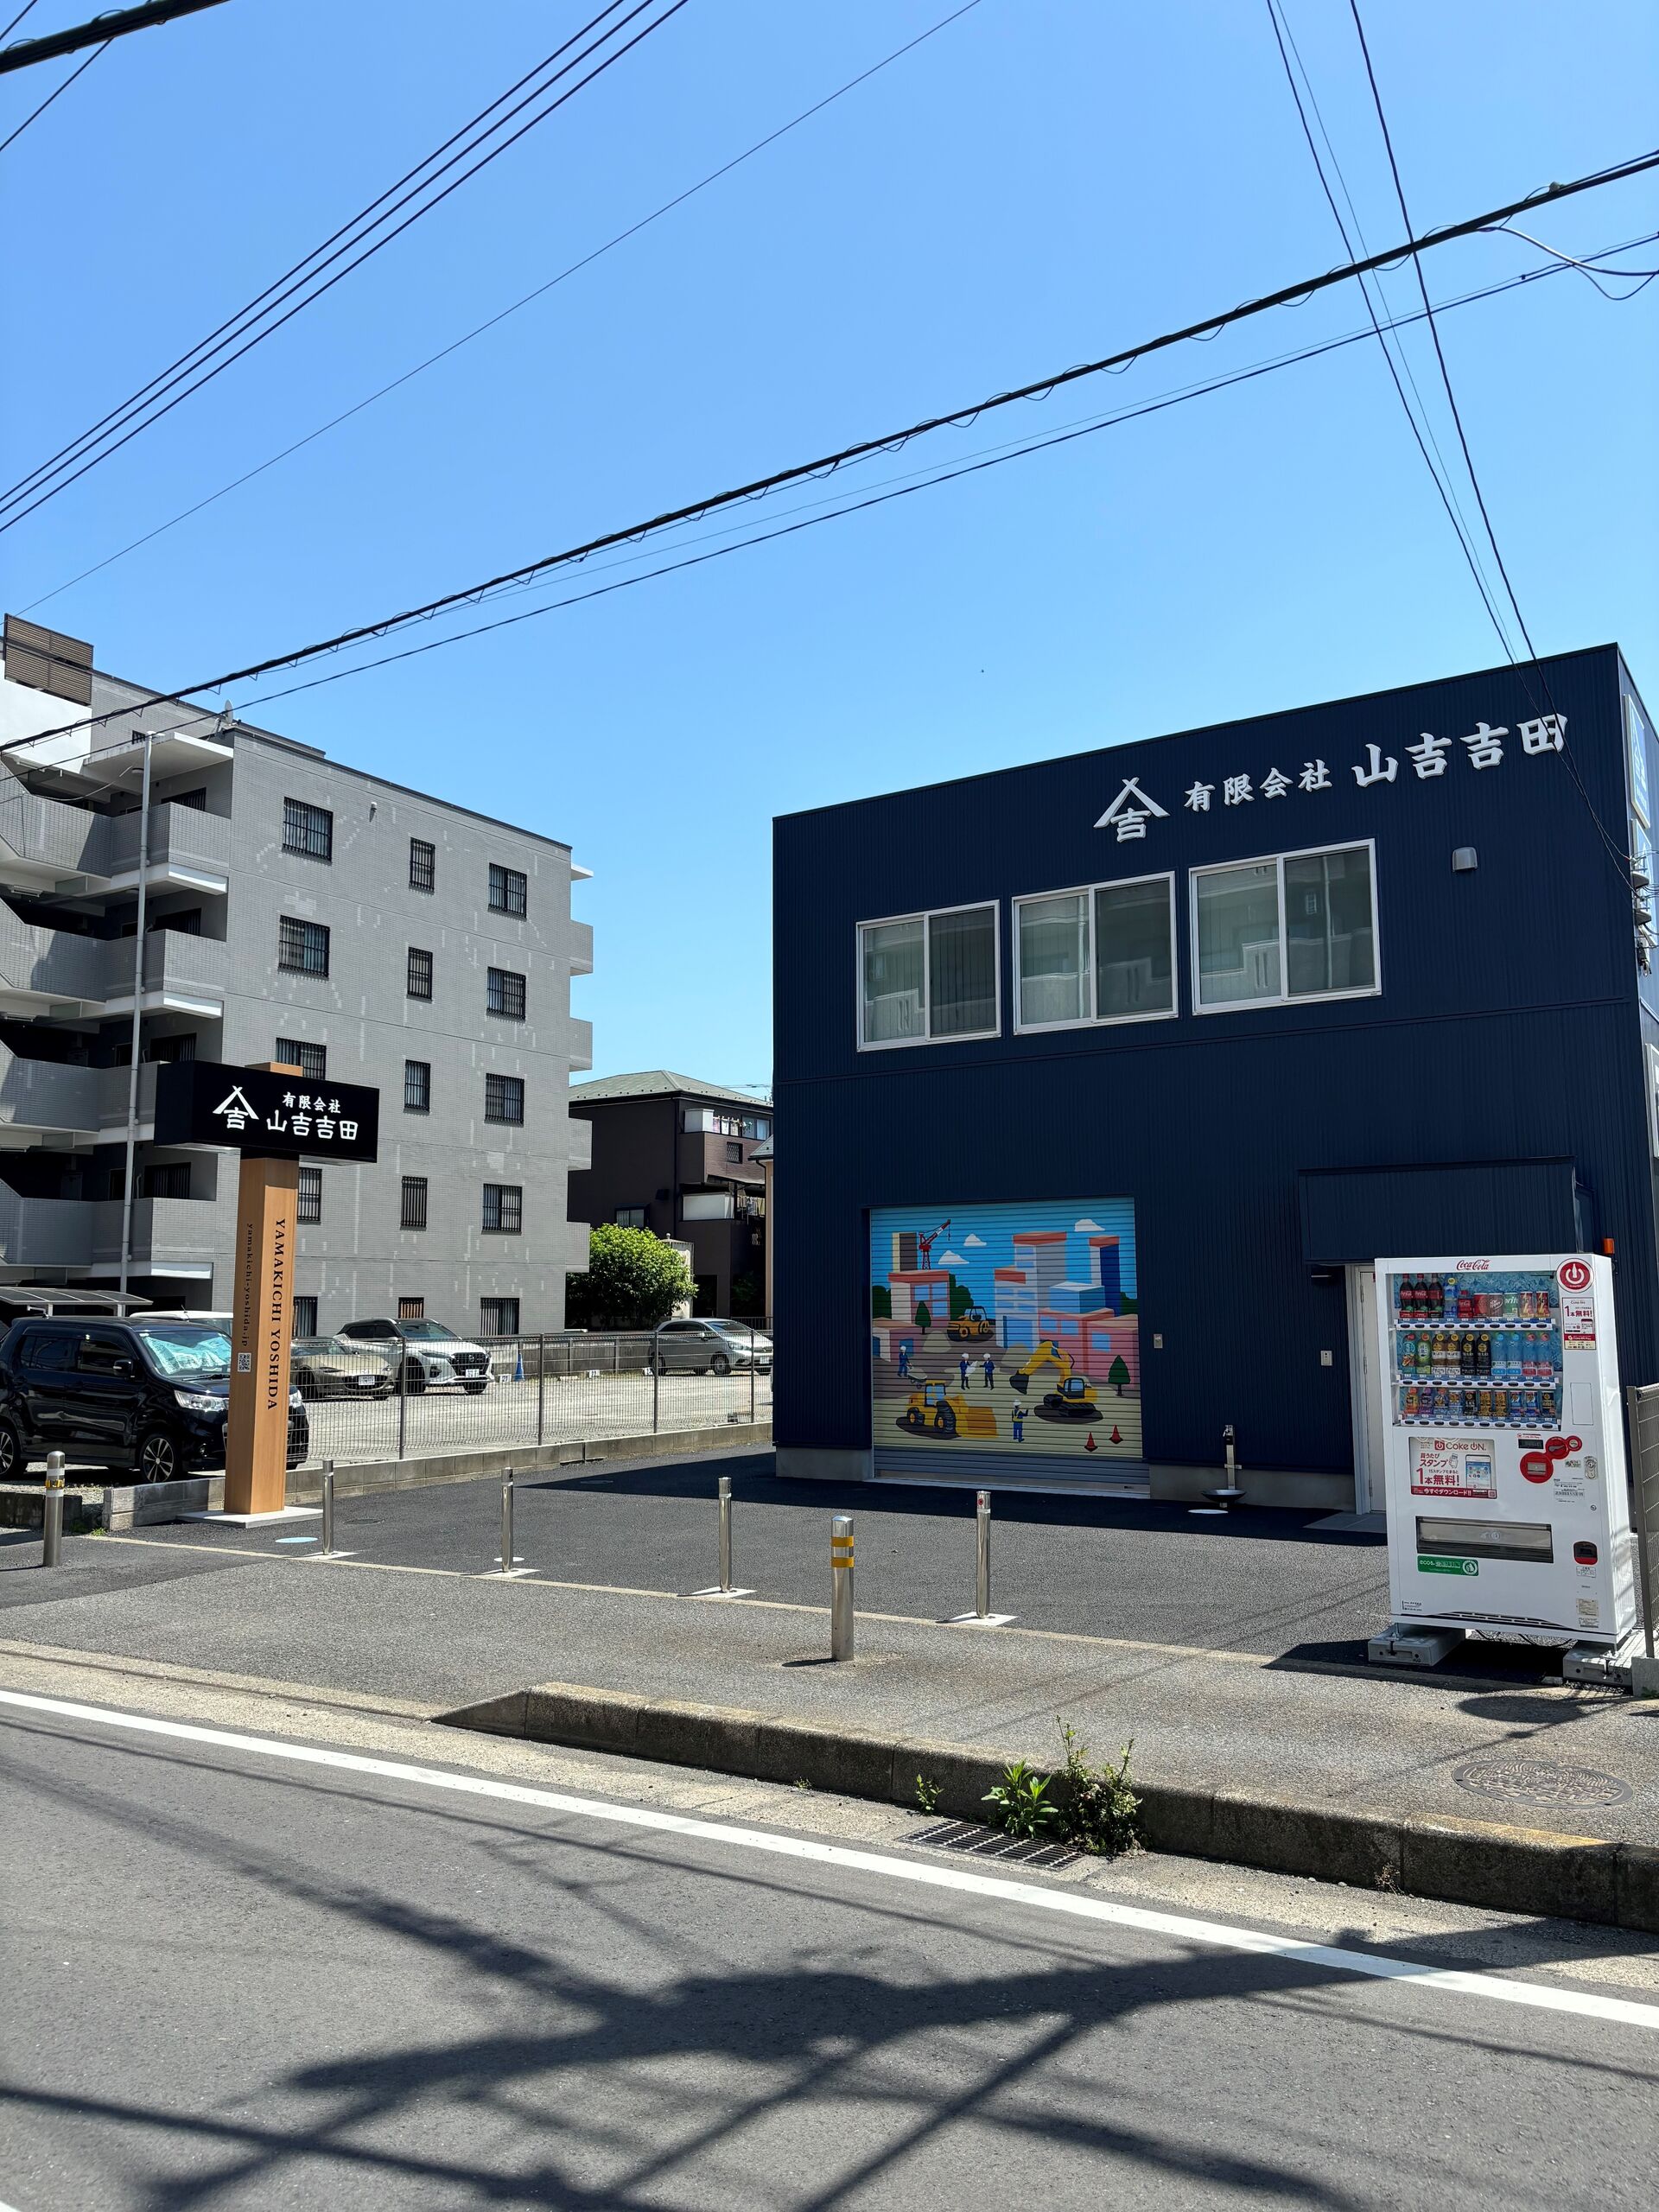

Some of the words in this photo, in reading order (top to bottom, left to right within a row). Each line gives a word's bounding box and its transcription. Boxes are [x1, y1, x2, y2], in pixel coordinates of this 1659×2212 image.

[1184, 759, 1332, 813] 有限会社
[1351, 713, 1568, 788] 山吉吉田
[282, 1091, 341, 1114] 有限会社
[266, 1109, 359, 1141] 山吉吉田
[241, 1223, 253, 1347] yamakichi-yoshida.jp
[271, 1217, 286, 1321] YAMAKICHI
[267, 1329, 281, 1410] YOSHIDA
[1446, 1442, 1469, 1451] Coke
[1416, 1467, 1460, 1486] 1本無料!
[1420, 1459, 1449, 1468] スタンプ
